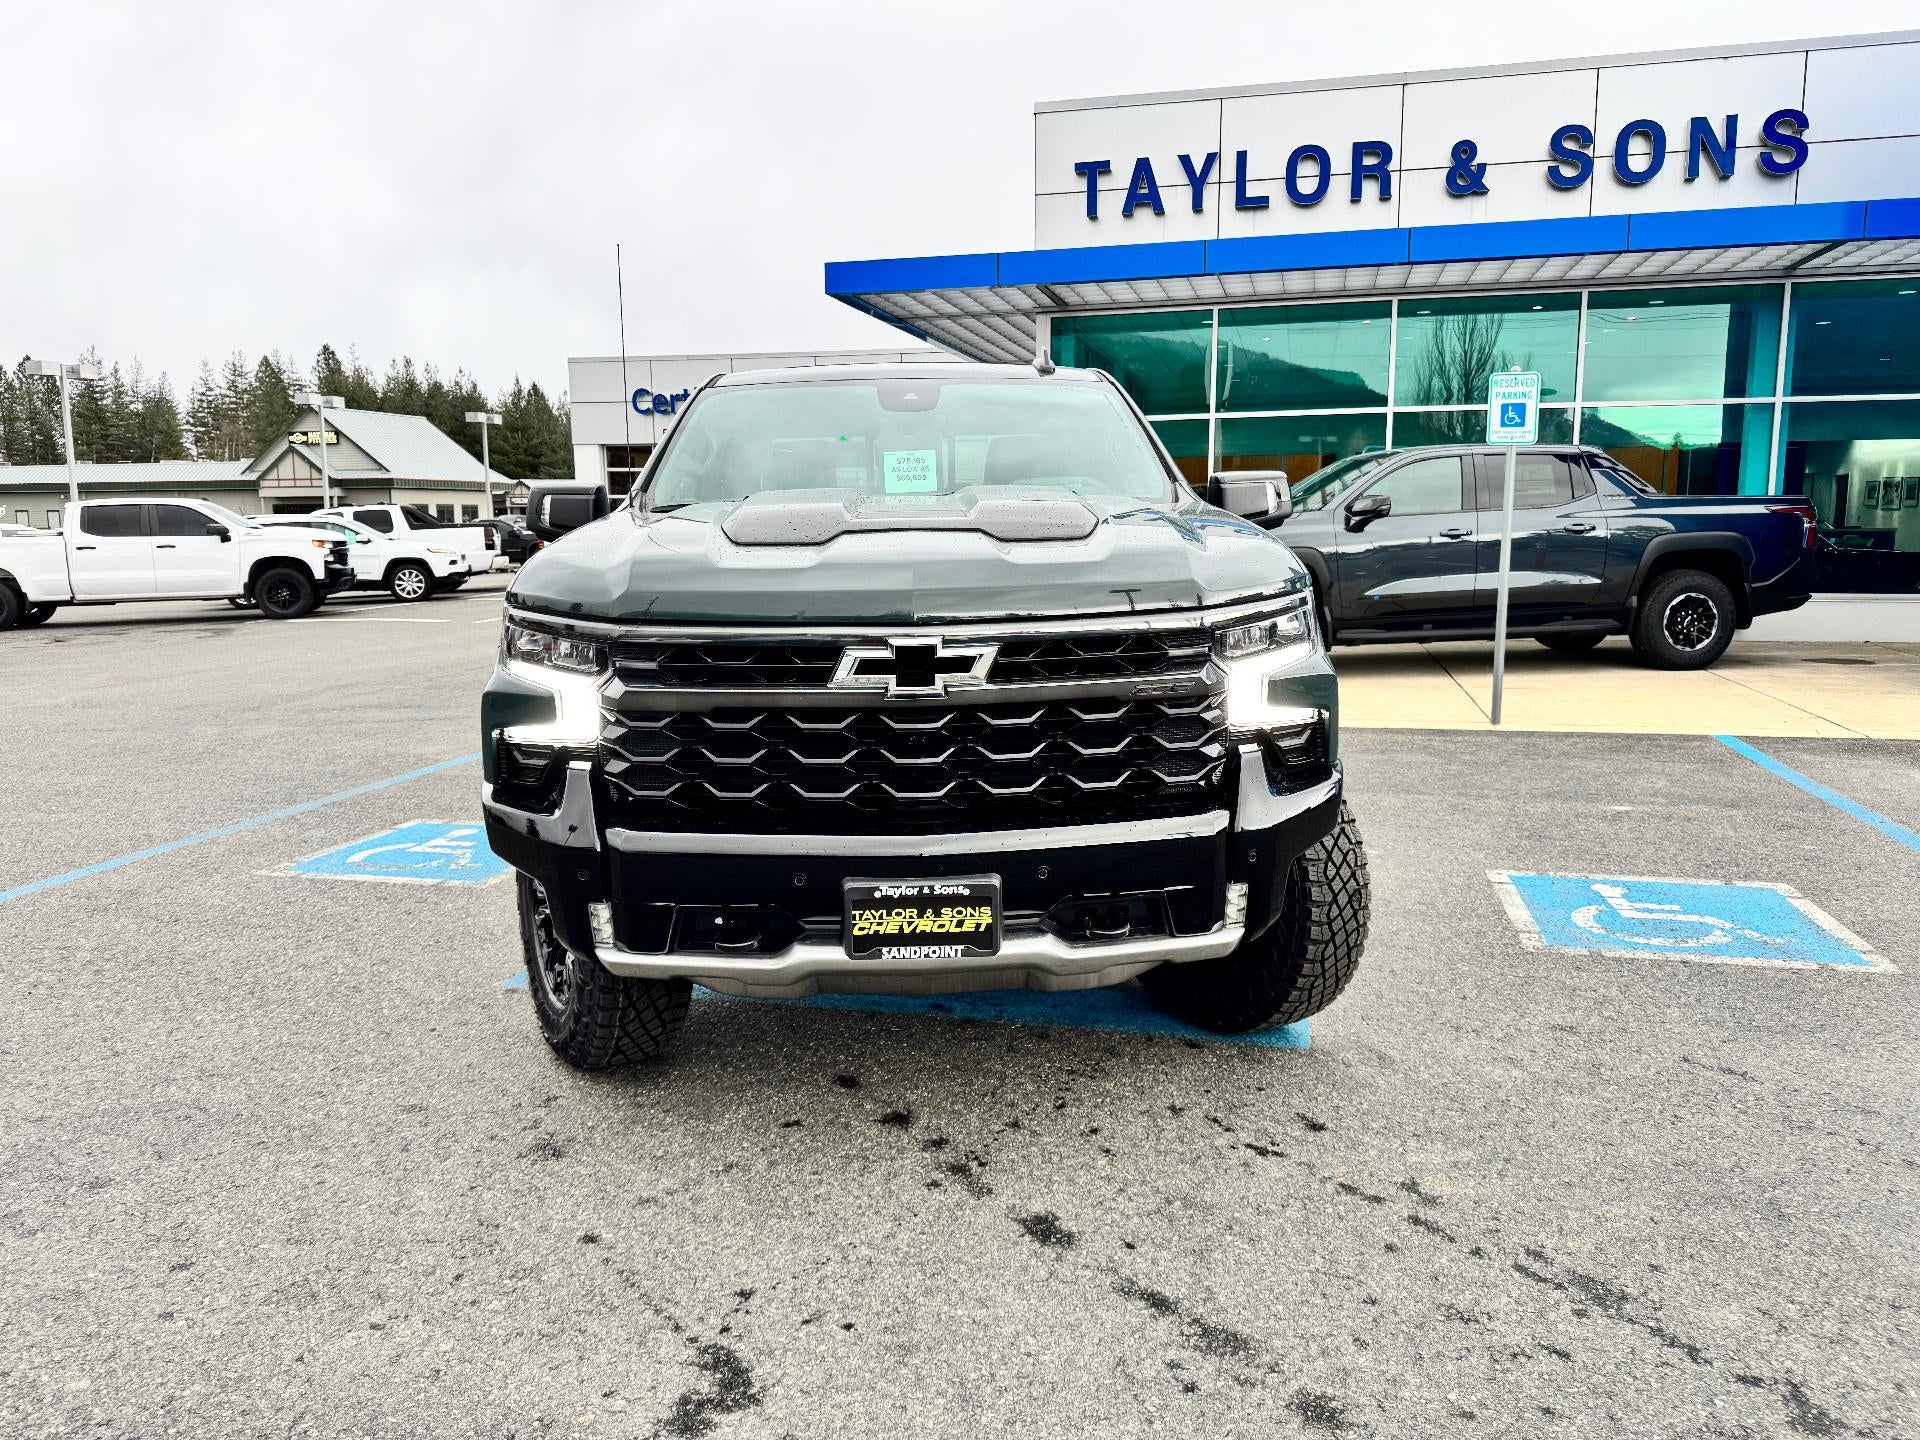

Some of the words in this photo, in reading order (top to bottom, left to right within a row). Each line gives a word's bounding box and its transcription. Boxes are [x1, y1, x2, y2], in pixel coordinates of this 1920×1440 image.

[1075, 141, 1394, 219] TAYLOR
[1445, 138, 1490, 197] &
[1548, 109, 1810, 191] SONS
[1494, 378, 1535, 388] RESERVED
[632, 388, 692, 415] Cert
[1495, 390, 1533, 400] PARKING
[879, 886, 919, 898] Taylor
[923, 886, 930, 894] &
[934, 885, 964, 895] Sons
[852, 908, 918, 921] TAYLOR
[924, 908, 934, 920] &
[941, 906, 992, 918] SONS
[853, 919, 992, 935] CHEVROLET
[881, 946, 964, 960] SANDPOINT
